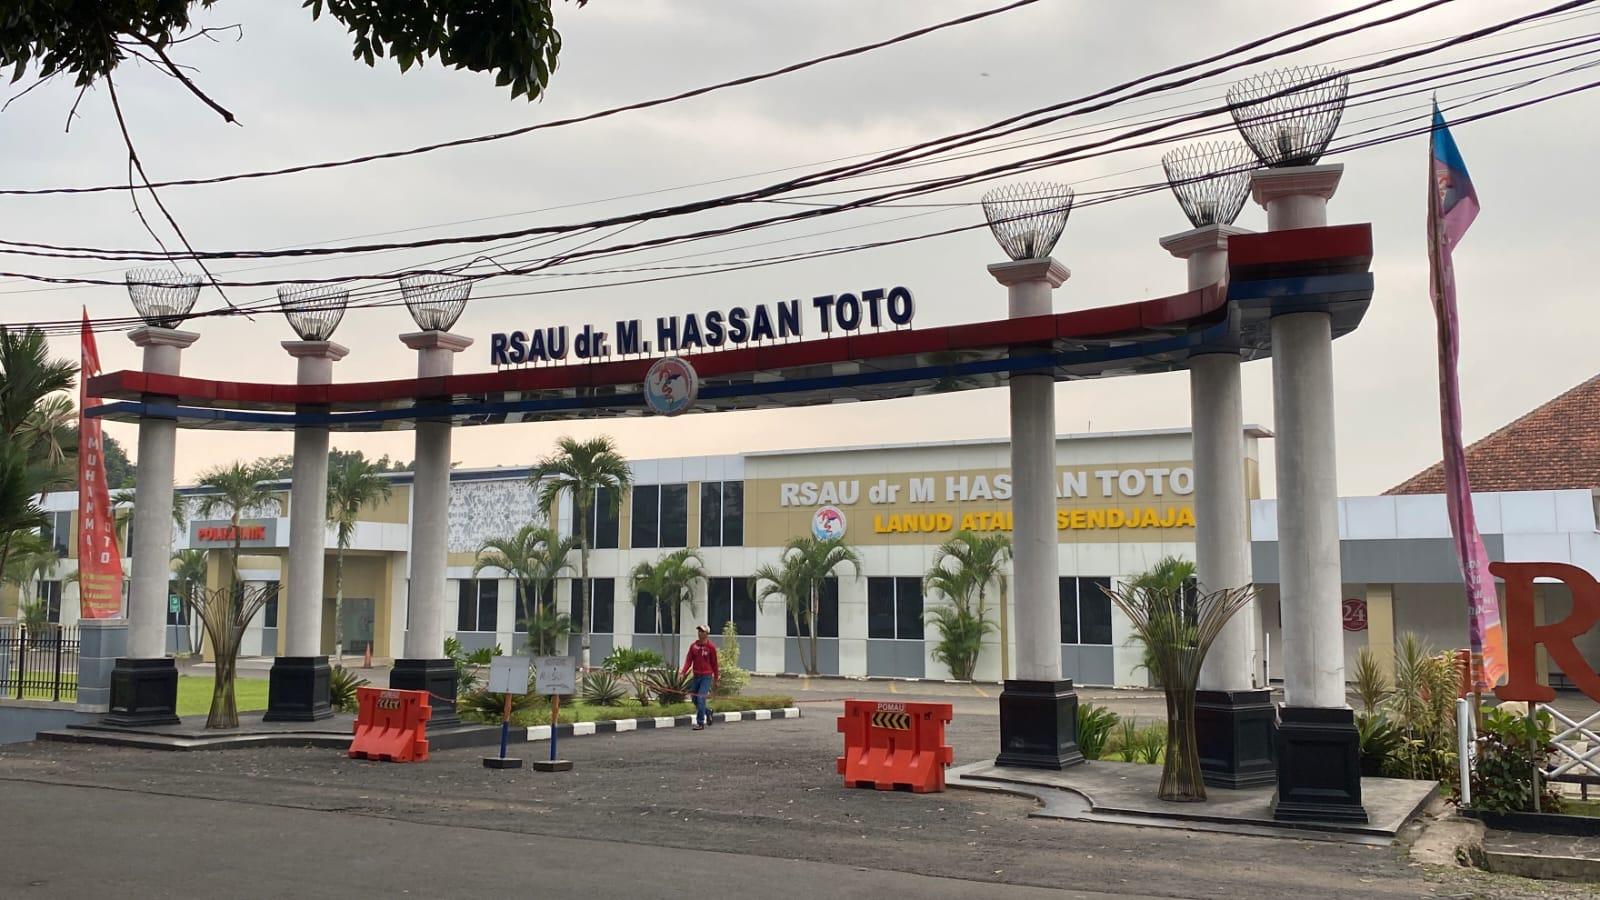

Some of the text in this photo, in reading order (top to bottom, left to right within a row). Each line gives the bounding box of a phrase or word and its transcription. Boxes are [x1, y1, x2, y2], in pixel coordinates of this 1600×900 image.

[491, 286, 916, 365] RSAU dr. M. HASSAN TOTO
[781, 467, 1194, 507] RSAU dr M HASN TOTO
[874, 505, 1196, 534] LANUD ATA SENDJAJA
[1343, 604, 1367, 622] 24
[877, 703, 904, 712] POMAU
